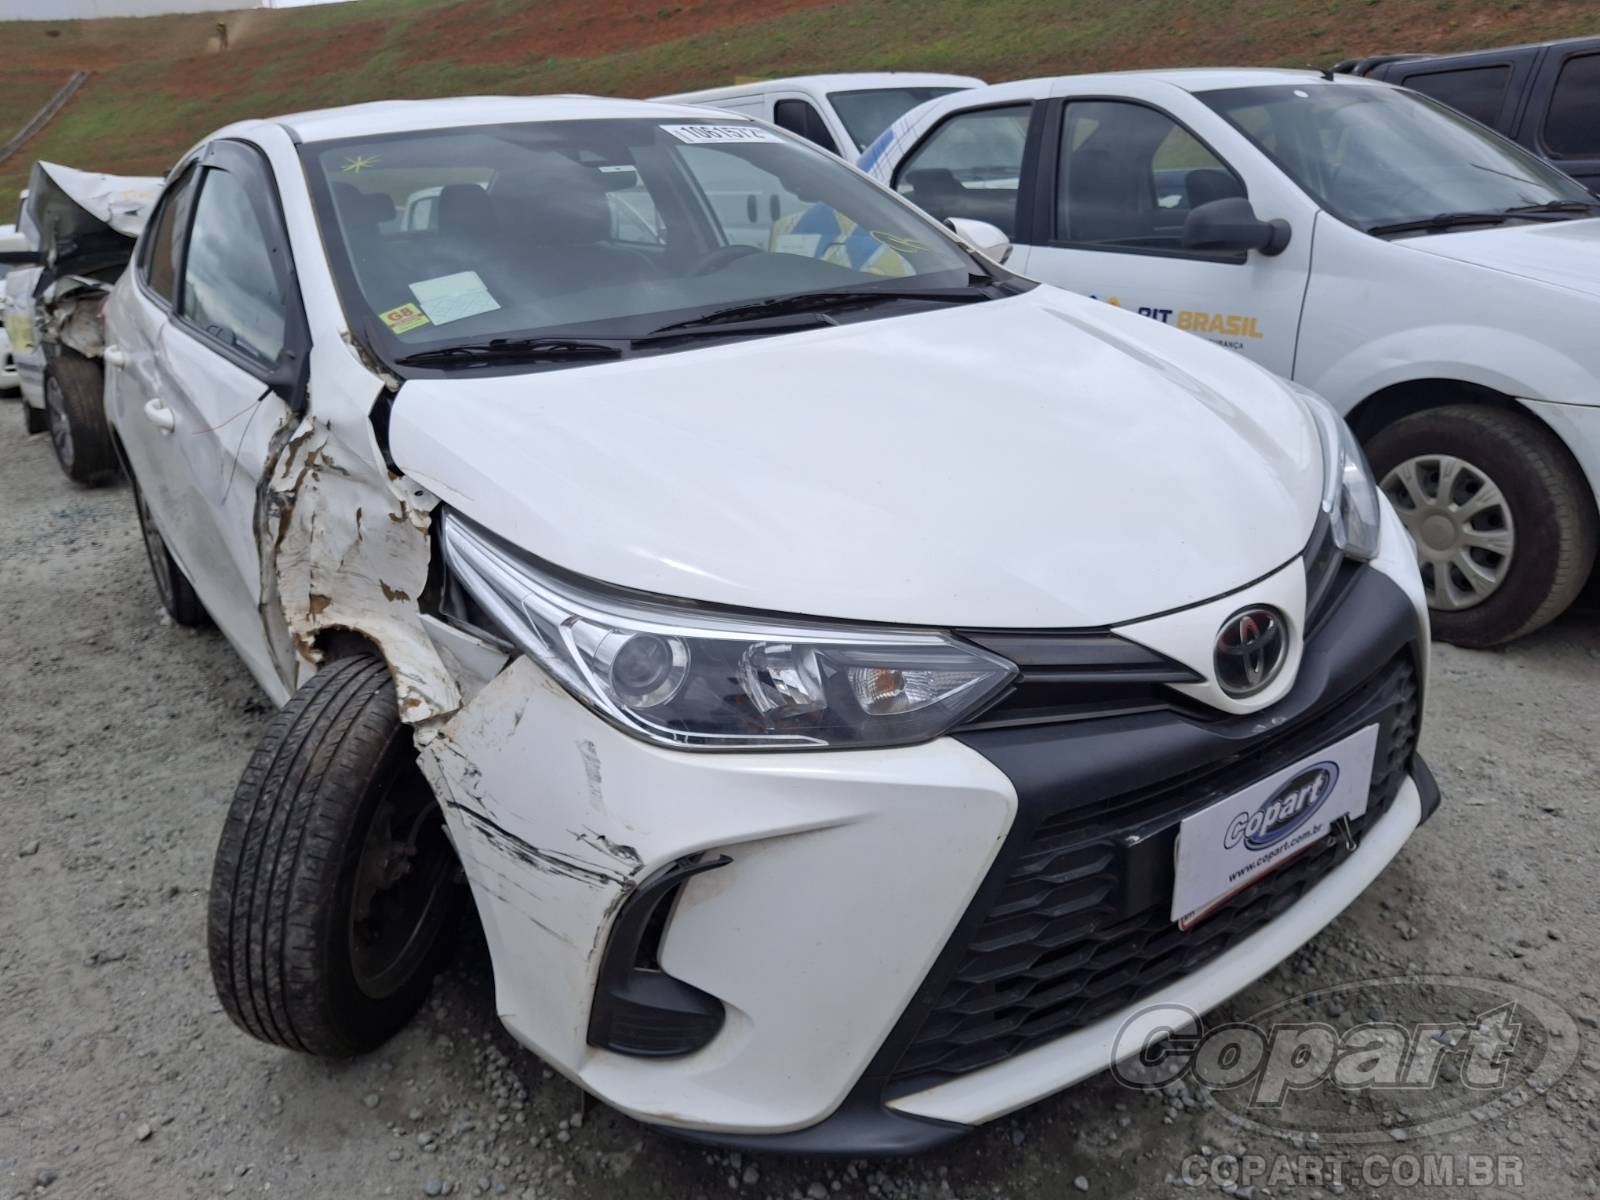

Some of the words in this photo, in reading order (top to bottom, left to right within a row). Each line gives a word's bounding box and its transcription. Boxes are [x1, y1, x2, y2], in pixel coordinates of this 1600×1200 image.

[1178, 310, 1263, 337] BRASIL
[1223, 769, 1327, 850] Copart
[1228, 823, 1323, 882] www.copart.com.br
